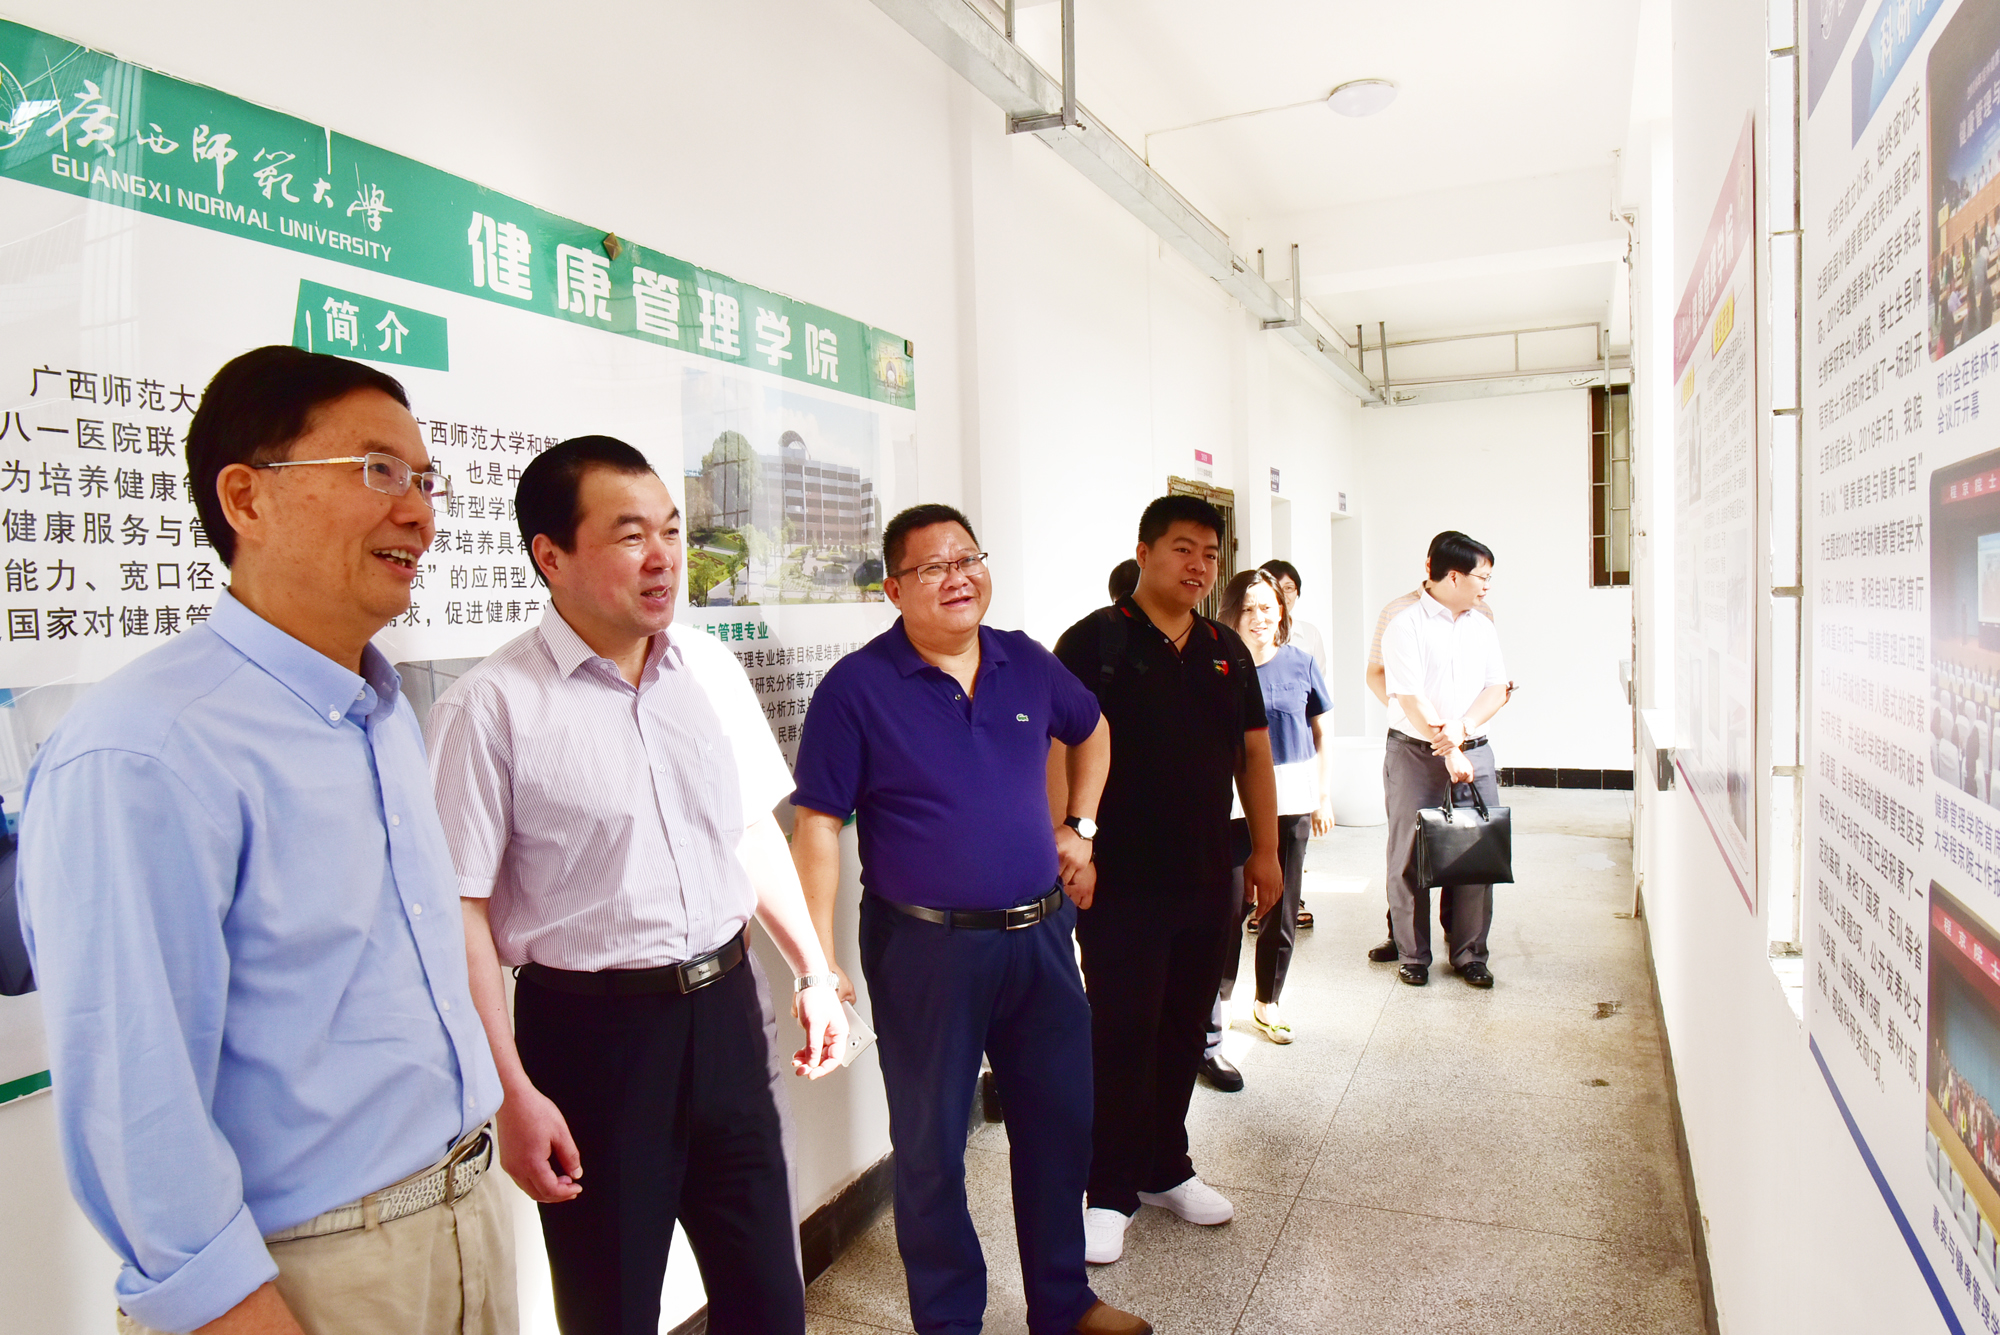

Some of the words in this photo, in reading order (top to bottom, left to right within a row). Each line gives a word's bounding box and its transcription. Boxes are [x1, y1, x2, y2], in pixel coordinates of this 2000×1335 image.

[1880, 0, 1927, 78] 科研
[52, 153, 171, 204] GUANGXI
[178, 189, 275, 232] NORMAL
[280, 217, 392, 262] UNIVERSITY
[468, 211, 839, 383] 健康管理学院
[322, 296, 409, 354] 简介
[1937, 341, 2000, 399] 研讨会在桂林市
[30, 365, 196, 415] 广西师范大
[416, 417, 568, 455] 西师范大学和解
[1937, 390, 1980, 434] 会议厅开幕
[0, 411, 189, 457] 八一医院联
[433, 495, 517, 521] 新型学
[1950, 473, 1997, 499] 程京院士
[2, 508, 213, 548] 健康服务与管
[385, 599, 546, 627] 求，促进健康产
[692, 621, 769, 642] 与管理专业
[749, 669, 828, 694] 研究分析等方面
